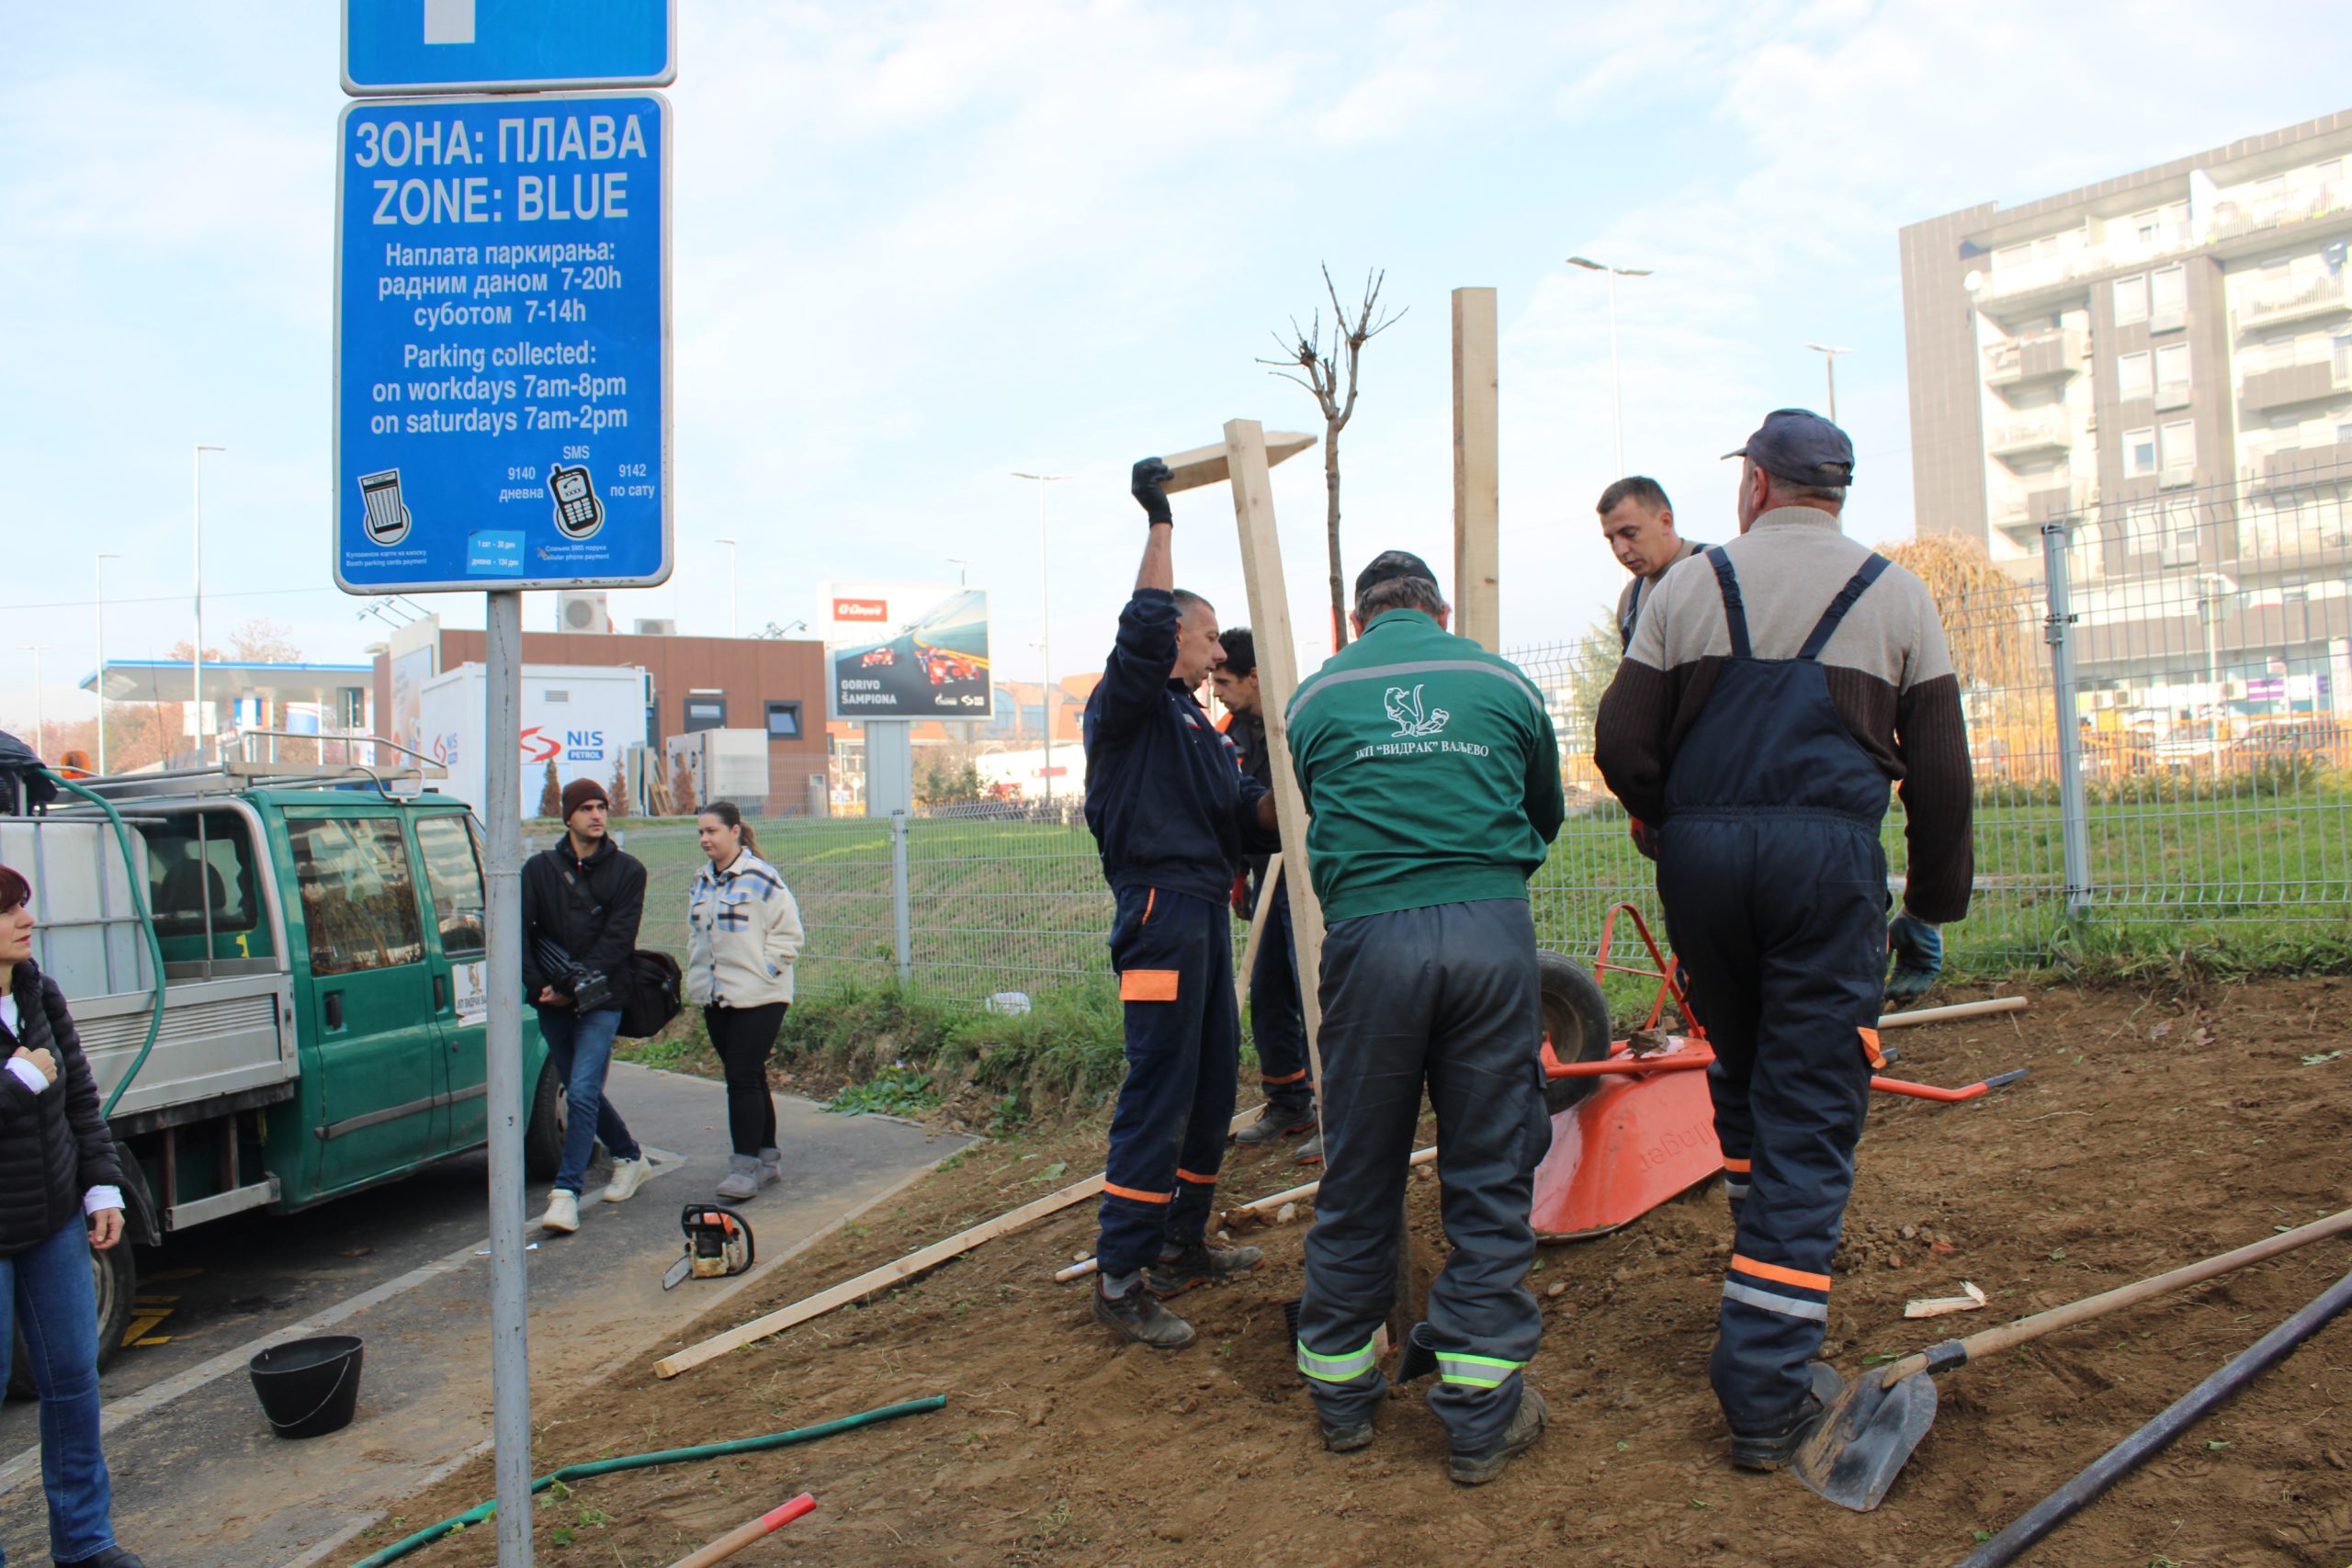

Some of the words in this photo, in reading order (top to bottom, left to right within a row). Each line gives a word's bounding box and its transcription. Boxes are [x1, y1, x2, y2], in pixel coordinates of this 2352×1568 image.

[356, 120, 482, 167] ЗОНА:
[499, 114, 647, 163] ПЛАВА
[373, 177, 501, 225] ZONE:
[518, 172, 628, 220] BLUE
[386, 243, 478, 266] Наплата
[485, 242, 615, 270] паркирања:
[379, 276, 466, 300] радним
[473, 274, 548, 299] даном
[561, 265, 621, 290] 7-20h
[414, 301, 512, 332] суботом
[526, 298, 586, 322] 7-14h
[404, 344, 485, 373] Parking
[492, 340, 596, 367] collected:
[372, 383, 401, 401] on
[408, 376, 516, 405] workdays
[524, 373, 627, 402] 7am-8pm
[371, 415, 399, 434] on
[406, 408, 517, 436] saturdays
[525, 404, 628, 434] 7am-2pm
[562, 446, 590, 459] SMS
[507, 467, 536, 480] 9140
[618, 463, 647, 478] 9142
[499, 488, 544, 502] дневна
[610, 486, 625, 497] по
[628, 485, 655, 499] сату
[402, 558, 427, 566] payment
[584, 553, 610, 561] payment
[841, 680, 880, 690] GORIVO
[841, 691, 897, 705] ŠAMPIONA
[567, 731, 604, 746] NIS
[571, 750, 600, 760] PETROL
[1441, 740, 1488, 758] ВАЉЕВО
[1638, 1116, 1715, 1172] llager
